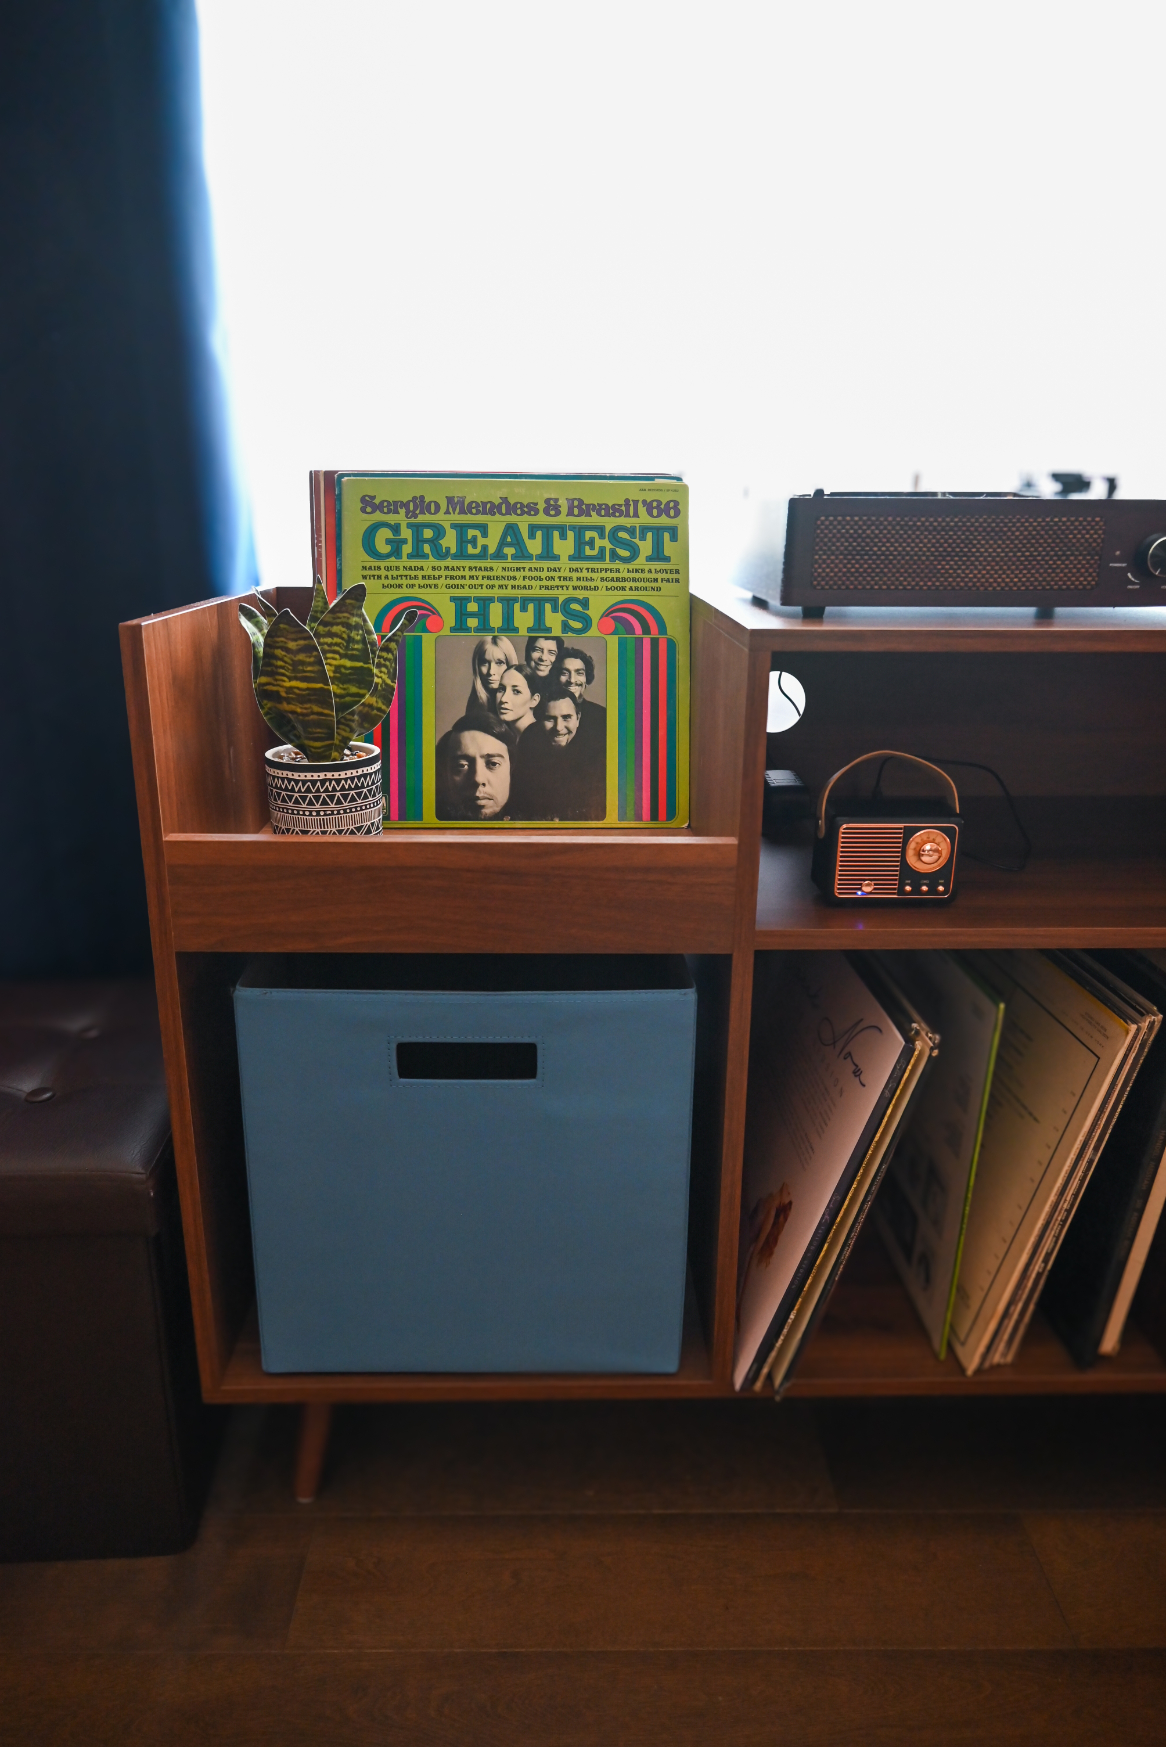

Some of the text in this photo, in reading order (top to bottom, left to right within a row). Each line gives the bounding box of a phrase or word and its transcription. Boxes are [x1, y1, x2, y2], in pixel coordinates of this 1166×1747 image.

[359, 495, 440, 519] Sergio
[443, 495, 539, 516] Mendes
[542, 497, 562, 517] &
[565, 497, 640, 519] Brasil
[361, 521, 678, 563] GREATEST
[450, 596, 592, 635] HITS
